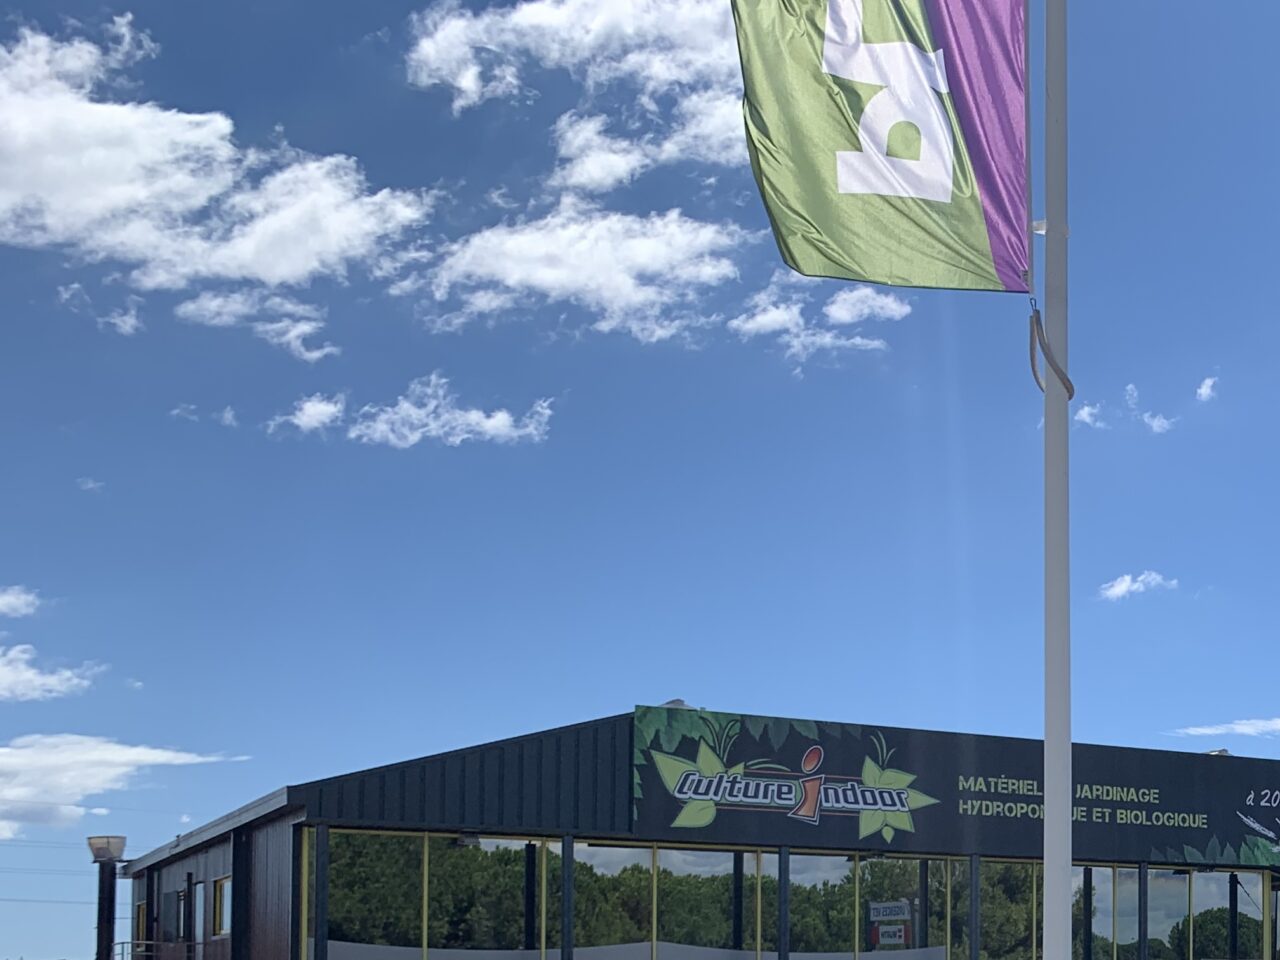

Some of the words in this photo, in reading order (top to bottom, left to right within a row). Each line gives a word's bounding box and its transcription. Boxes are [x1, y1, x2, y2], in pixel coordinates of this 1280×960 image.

[675, 771, 795, 805] Culture
[958, 774, 1043, 796] MATÉRIEL
[1075, 784, 1160, 804] JARDINAGE
[1093, 808, 1111, 824] ET
[1116, 809, 1208, 829] BIOLOGIQUE
